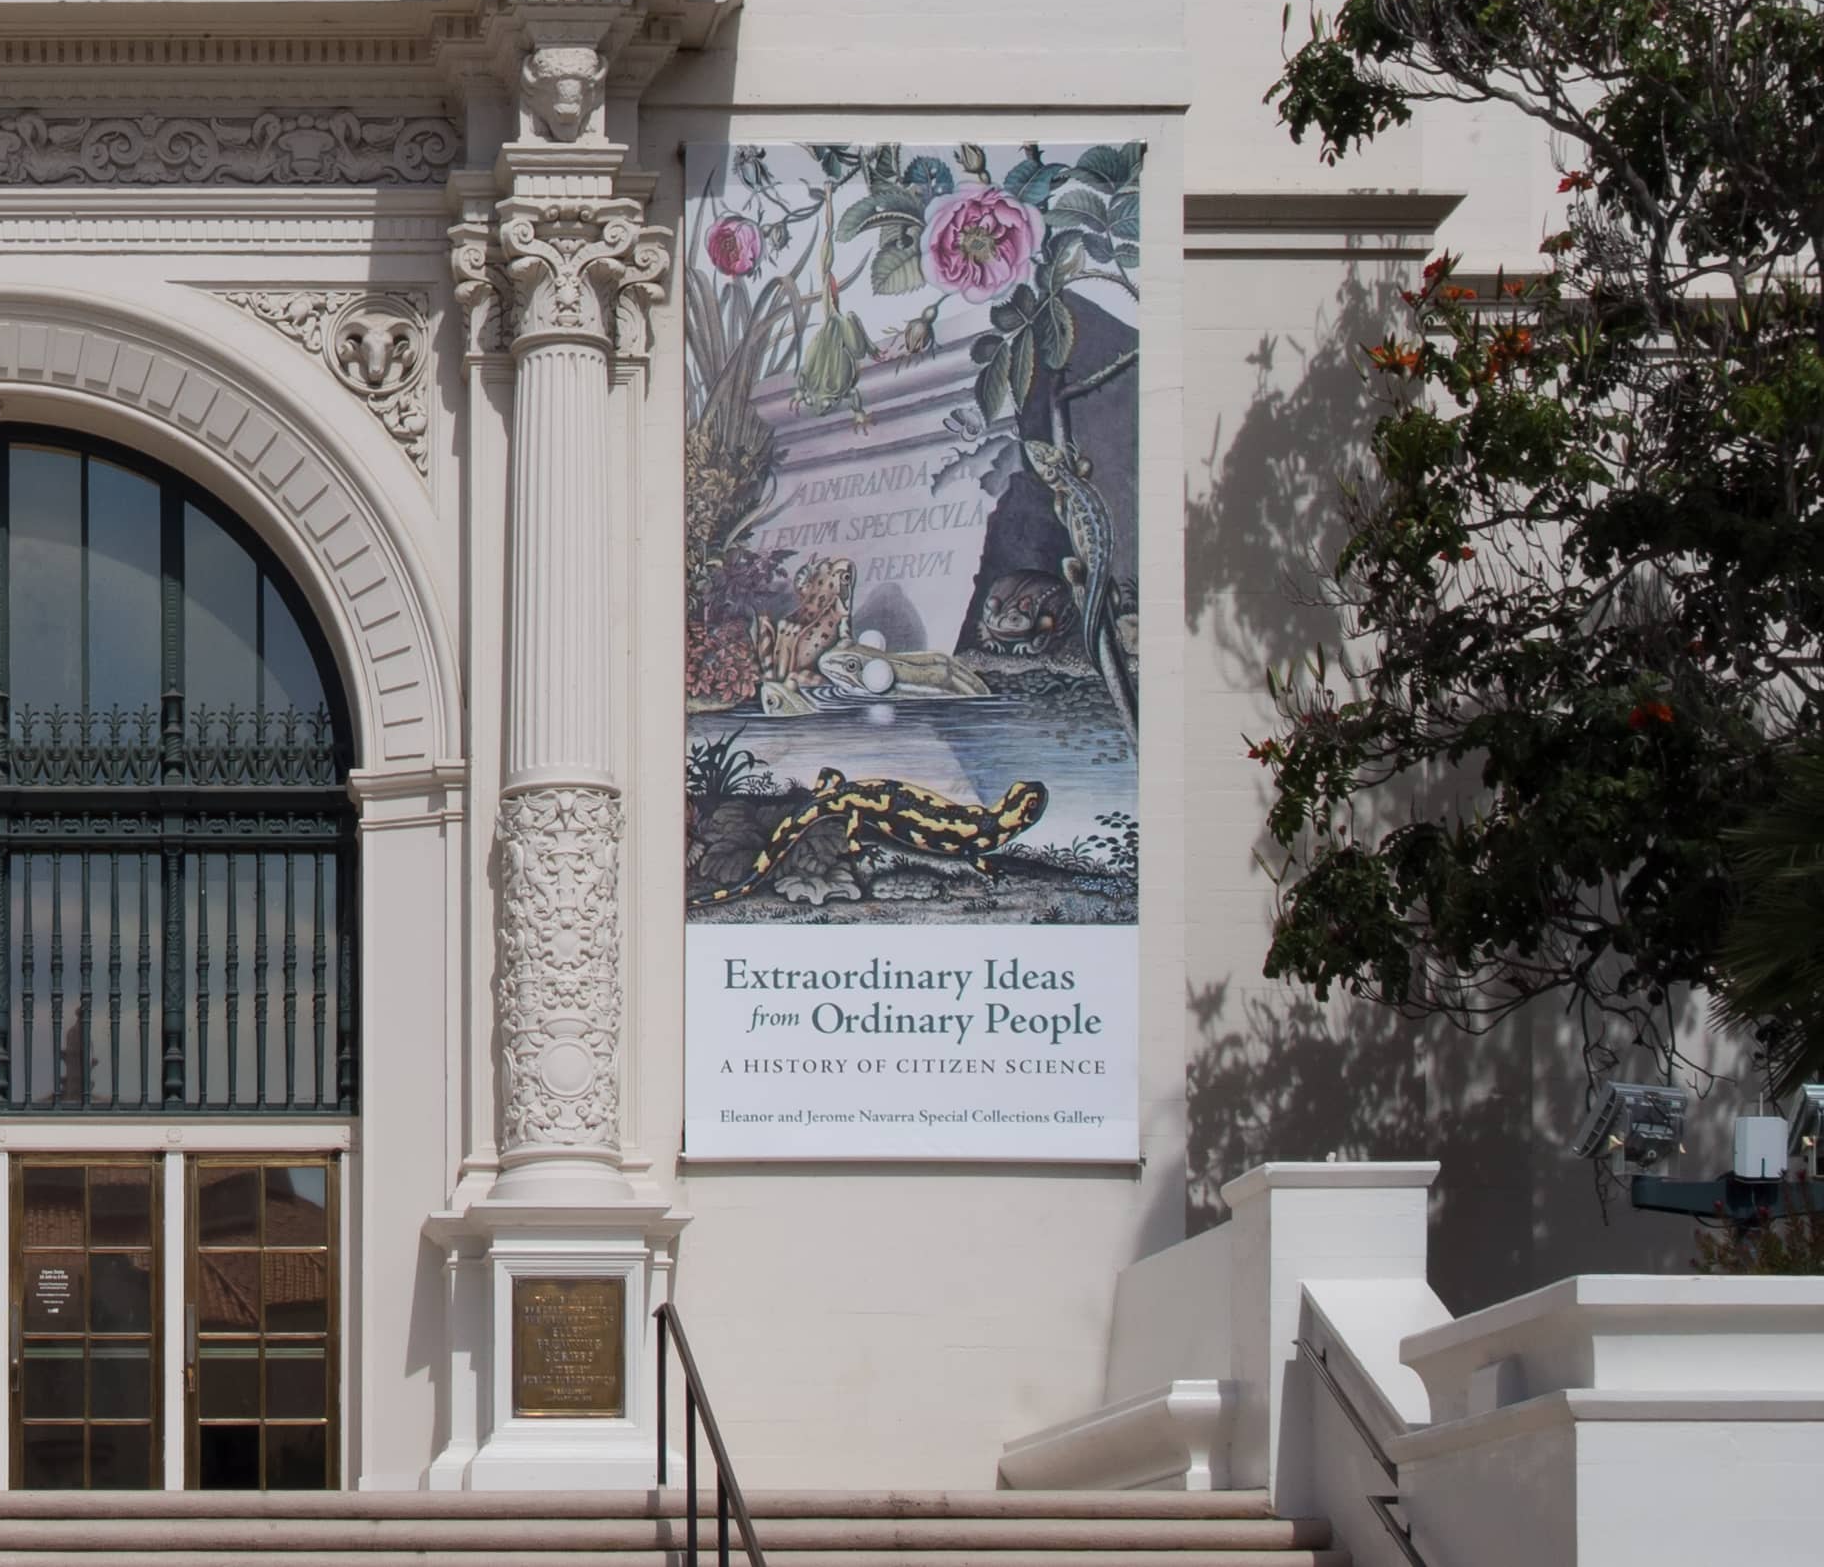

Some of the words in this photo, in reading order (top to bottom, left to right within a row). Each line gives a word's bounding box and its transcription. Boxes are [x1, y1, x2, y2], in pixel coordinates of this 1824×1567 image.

[795, 461, 929, 505] ADMIRANDA
[847, 501, 983, 541] SPECTACVLA
[867, 551, 951, 581] RERVM
[724, 958, 973, 1000] Extraordinary
[984, 958, 1074, 989] Ideas
[746, 1005, 799, 1033] from
[811, 1001, 974, 1045] Ordinary
[986, 1003, 1101, 1044] People
[721, 1060, 732, 1073] A
[745, 1060, 847, 1073] HISTORY
[857, 1060, 885, 1073] OF
[897, 1059, 994, 1073] CITIZEN
[1006, 1060, 1104, 1074] SCIENCE
[721, 1110, 774, 1122] Eleanor
[778, 1110, 802, 1123] and
[805, 1110, 855, 1126] Jerome
[860, 1110, 914, 1122] Navarra
[919, 1110, 967, 1126] Special
[972, 1110, 1049, 1122] Collections
[1054, 1111, 1104, 1126] Gallery
